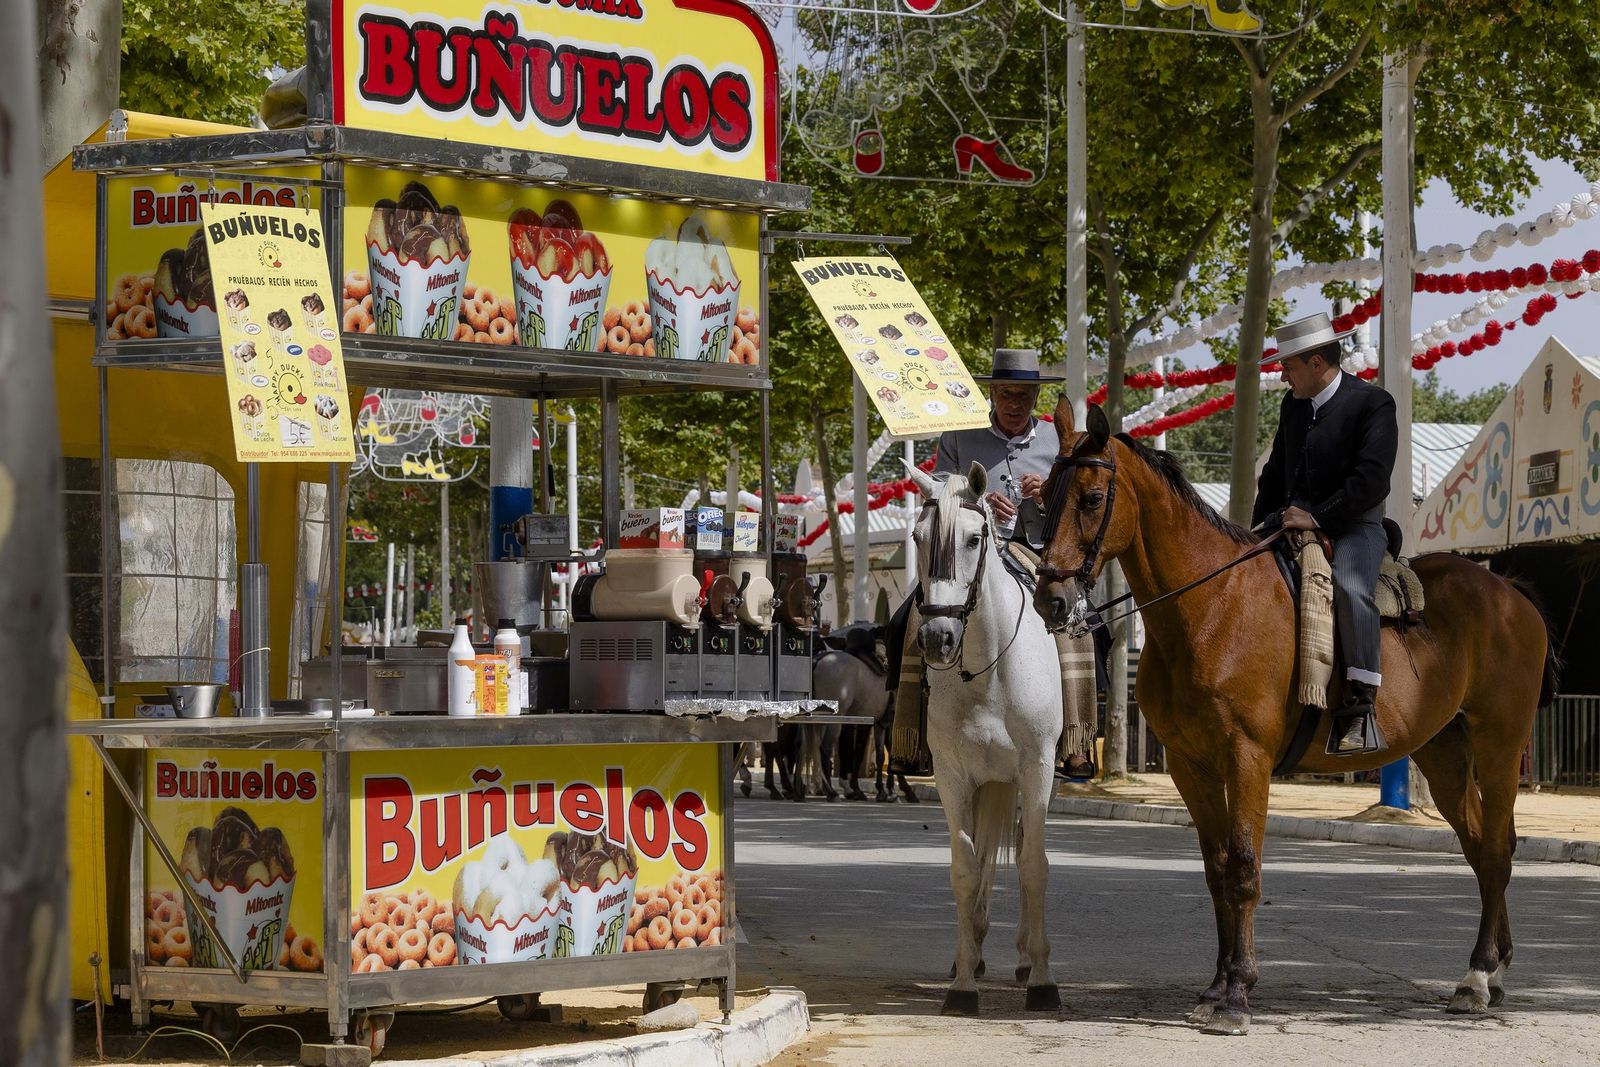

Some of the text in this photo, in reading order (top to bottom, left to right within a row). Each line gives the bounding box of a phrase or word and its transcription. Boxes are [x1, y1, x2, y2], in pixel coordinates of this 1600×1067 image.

[358, 10, 752, 153] BUÑUELOS
[208, 211, 321, 249] BUÑUELOS
[228, 275, 319, 287] PRUÉBALOS RECIÉN HECHOS
[426, 268, 461, 292] Mitomix
[801, 260, 906, 286] BUÑUELOS
[568, 283, 603, 307] Mitomix
[700, 298, 732, 321] Mitomix
[280, 364, 305, 380] DUCKY
[621, 516, 650, 532] bueno
[662, 514, 683, 526] bueno
[698, 508, 724, 523] OREO
[156, 760, 318, 800] Buñuelos
[363, 768, 710, 892] Buñuelos
[246, 890, 284, 916] Mitomix
[597, 887, 629, 914] Mitomix
[459, 925, 488, 955] Mitomix
[513, 924, 550, 955] Mitomix
